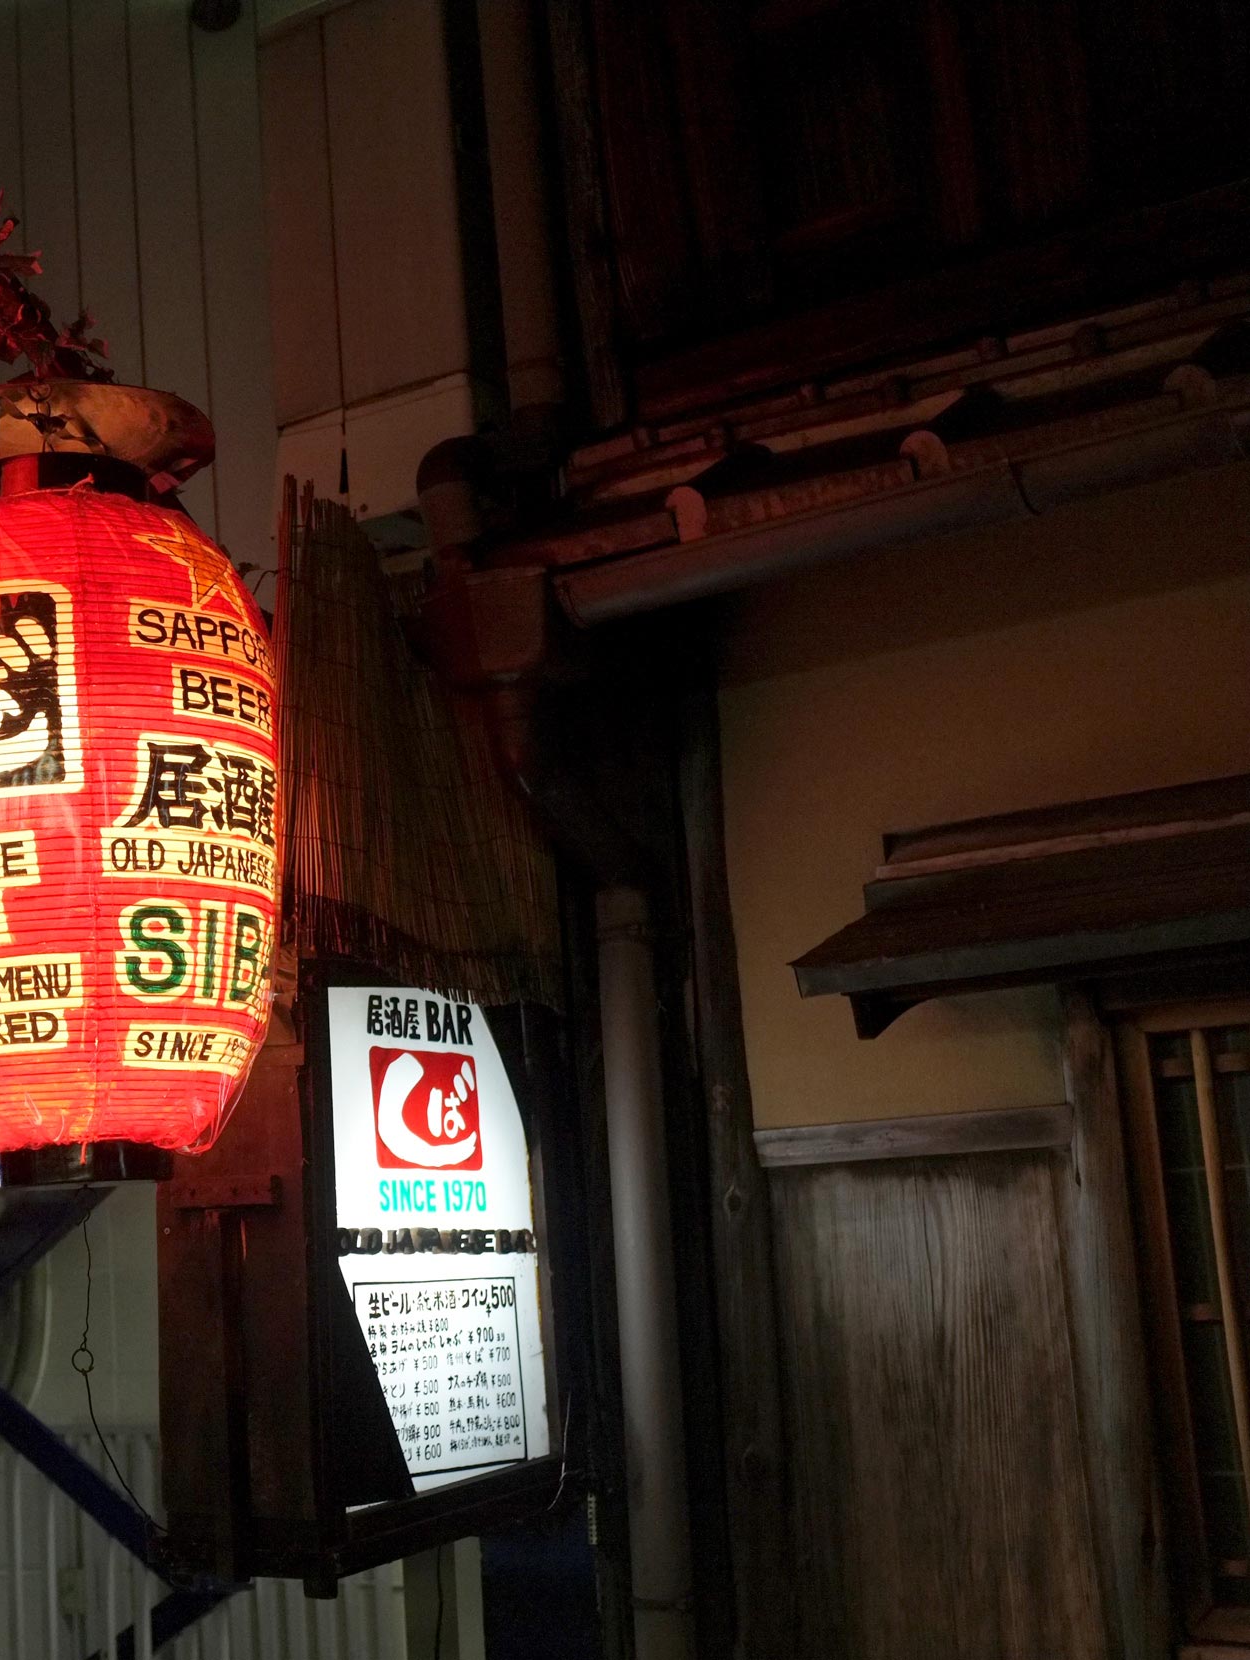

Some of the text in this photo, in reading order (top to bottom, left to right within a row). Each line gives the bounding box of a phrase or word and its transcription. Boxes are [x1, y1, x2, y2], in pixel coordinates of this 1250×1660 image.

[179, 668, 272, 732] BEER
[110, 837, 167, 872] OLD
[124, 905, 270, 1003] SIB
[366, 994, 474, 1046] 居酒屋 BAR
[132, 1030, 218, 1063] SINCE
[378, 1179, 487, 1213] SINCE 1970
